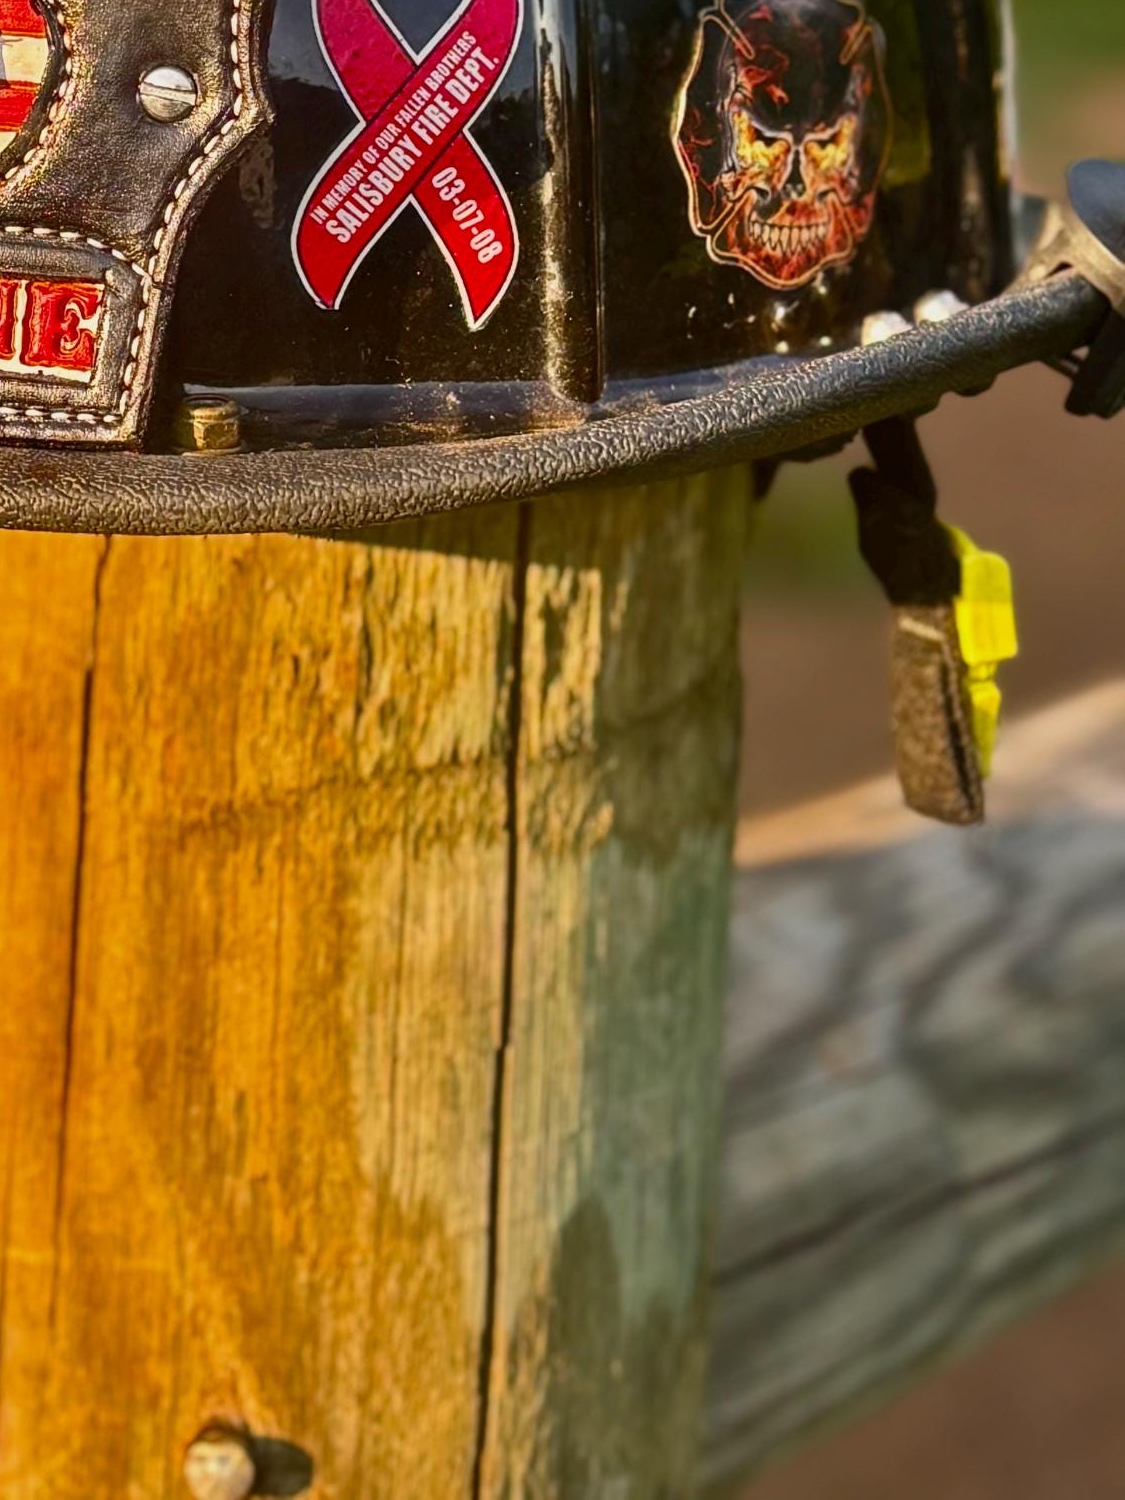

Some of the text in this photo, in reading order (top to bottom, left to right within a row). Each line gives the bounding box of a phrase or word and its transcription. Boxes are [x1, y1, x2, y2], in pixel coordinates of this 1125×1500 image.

[309, 30, 477, 225] IN MEMORY OF OUR FALLEN BROTHERS
[325, 46, 500, 244] SALISBURY FIRE DEPT.
[431, 166, 503, 264] 03-07-08
